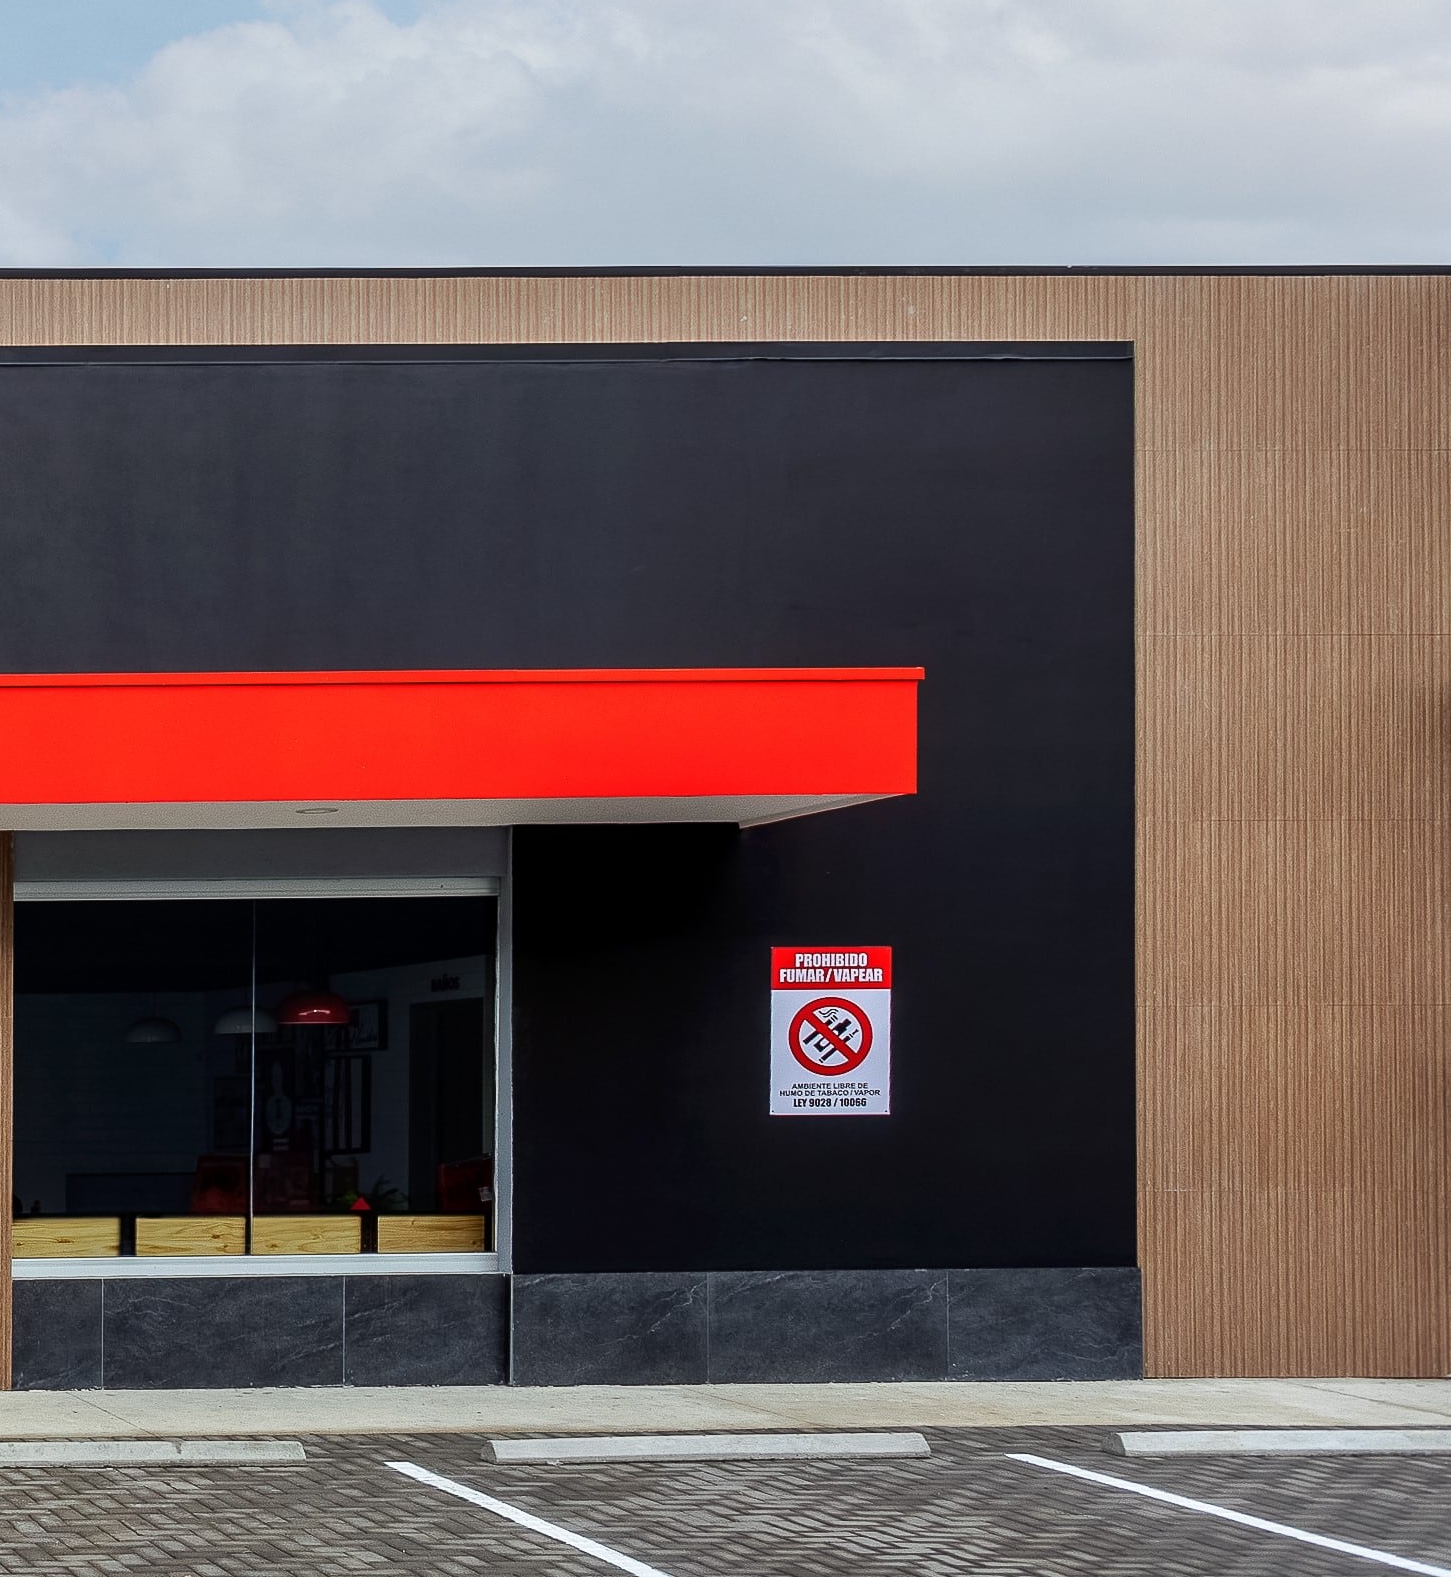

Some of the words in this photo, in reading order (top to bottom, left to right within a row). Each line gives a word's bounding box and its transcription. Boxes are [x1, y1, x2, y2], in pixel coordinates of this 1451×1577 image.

[795, 952, 868, 967] PROHIBIDO
[791, 1082, 832, 1090] AMBIENTE
[833, 1082, 856, 1090] LIBRE
[817, 1089, 849, 1097] TABACO
[793, 1098, 807, 1108] LEY
[808, 1098, 832, 1107] 9028
